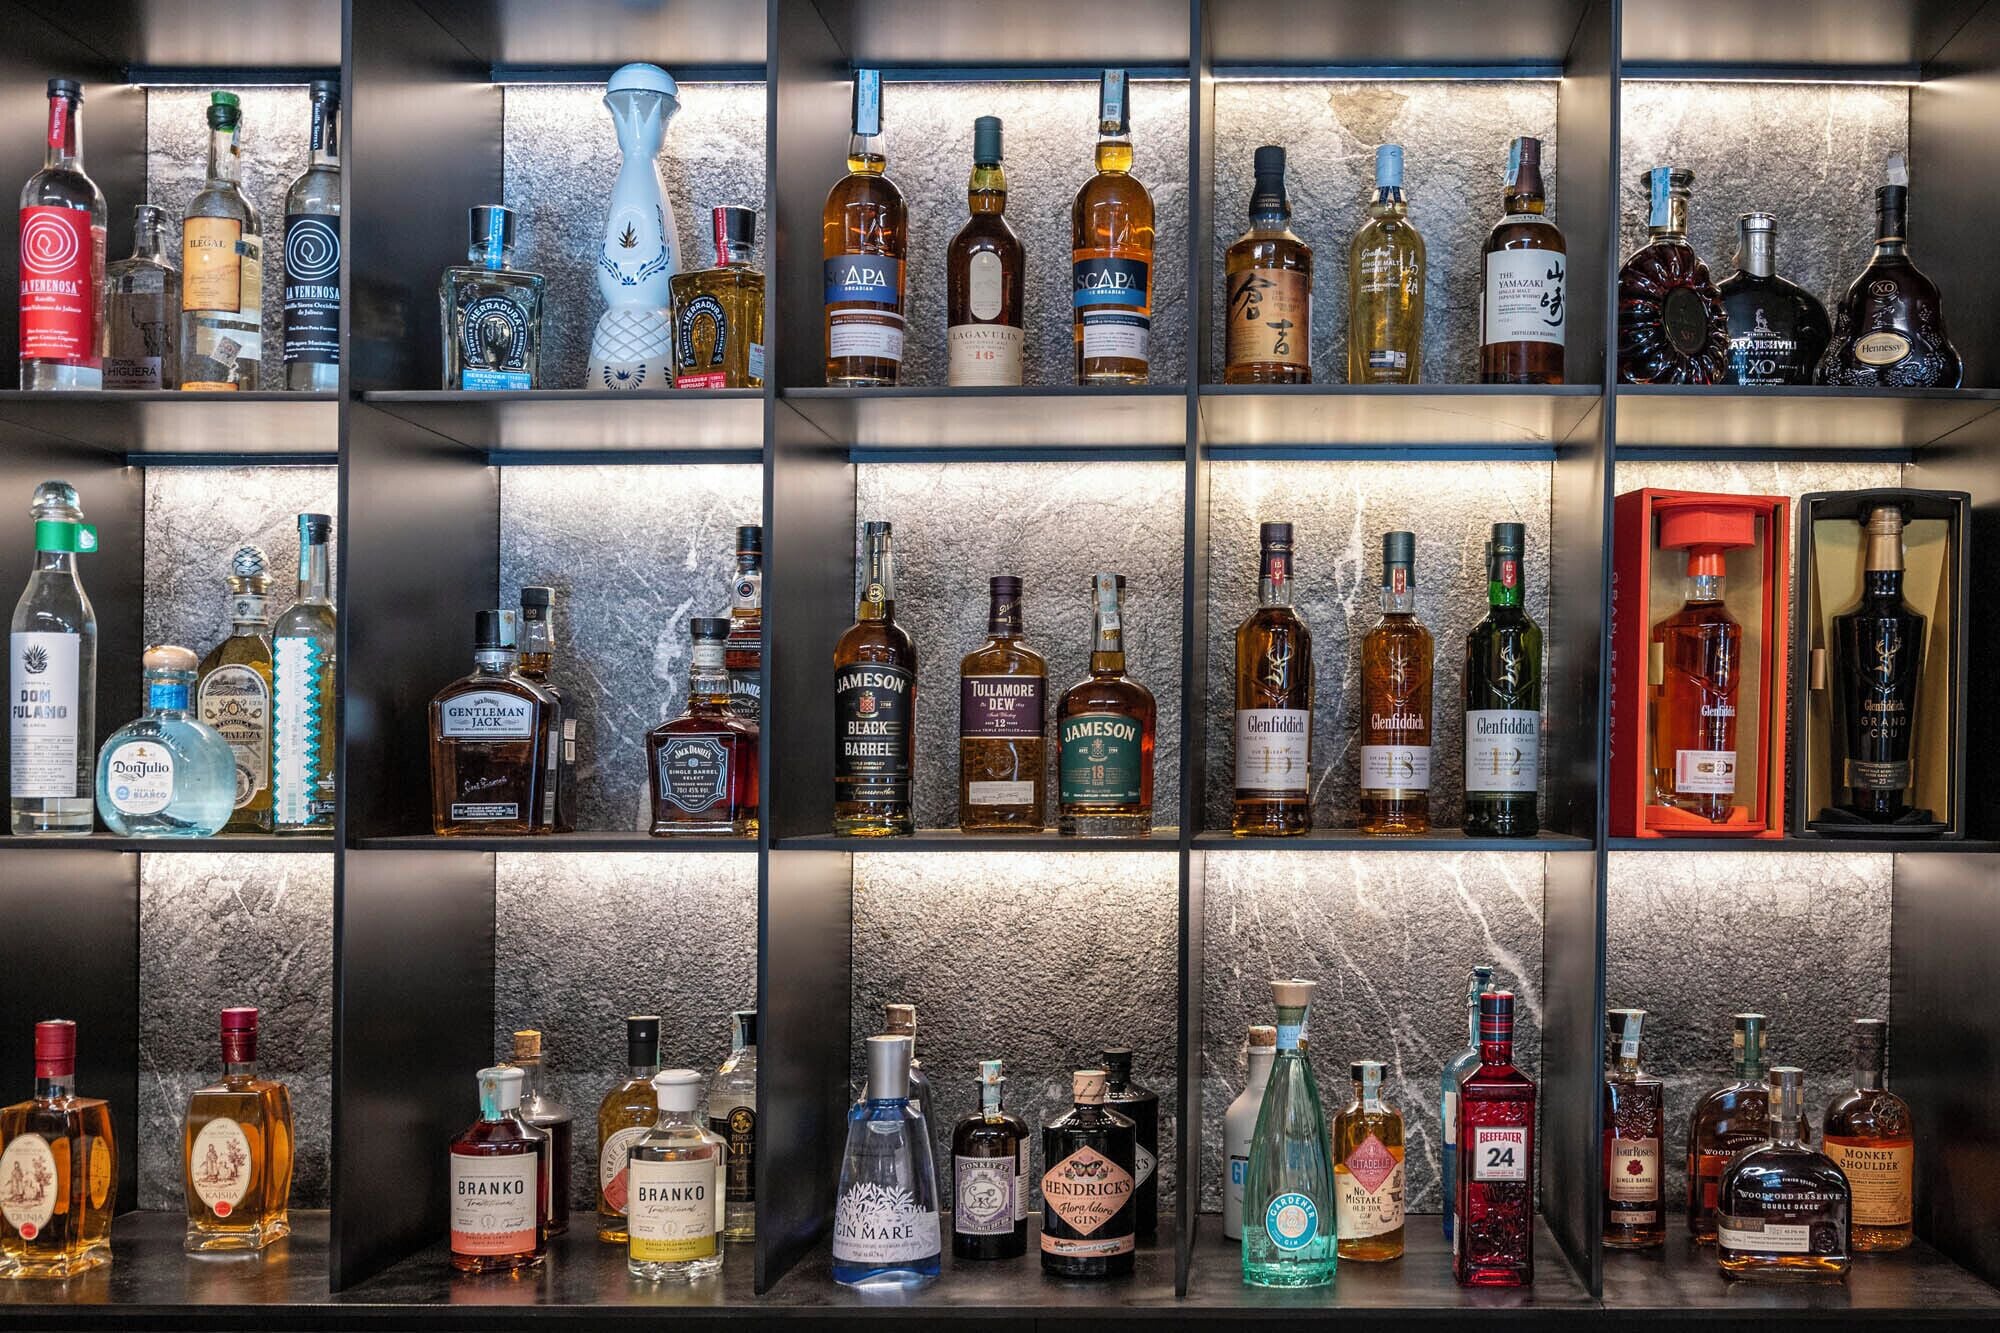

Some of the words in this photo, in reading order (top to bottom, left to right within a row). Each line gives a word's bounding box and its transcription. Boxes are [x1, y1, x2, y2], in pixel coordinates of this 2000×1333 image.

[190, 240, 226, 248] ILEGAL
[1077, 268, 1137, 289] SCAPA
[1499, 280, 1544, 288] YAMAZAKI
[30, 280, 77, 294] VENENOSA
[286, 287, 293, 299] LA
[294, 285, 340, 299] VENENOSA
[1876, 284, 1895, 293] XO
[470, 302, 522, 326] HERRADURA
[683, 301, 722, 323] HERRADURA
[953, 330, 1017, 341] LAGAVULIN
[975, 351, 995, 360] 16
[1862, 344, 1901, 353] Hennessy
[107, 367, 157, 376] HIGUERA
[1748, 359, 1776, 374] XO
[836, 673, 905, 694] JAMESON
[971, 681, 1035, 697] TULLAMORE
[13, 705, 67, 719] FULANO
[449, 707, 524, 717] GENTLEMAN
[472, 717, 502, 728] JACK
[848, 721, 888, 735] BLACK
[995, 719, 1006, 728] 12
[1248, 715, 1304, 733] Glenfiddich
[1861, 716, 1906, 726] GRAND
[1065, 721, 1136, 743] JAMESON
[1870, 728, 1898, 738] CRU
[675, 745, 688, 759] Jack
[689, 745, 712, 759] Daniel's
[845, 743, 893, 756] BARREL
[1264, 746, 1292, 774] 15
[1385, 751, 1413, 779] 18
[1490, 747, 1521, 776] 12
[113, 761, 140, 774] Don
[136, 761, 169, 778] Julio
[1092, 765, 1104, 779] 18
[1480, 1132, 1522, 1144] BEEFEATER
[1487, 1147, 1515, 1167] 24
[1845, 1149, 1893, 1159] MONKEY
[960, 1161, 998, 1172] MONKEY
[999, 1163, 1009, 1172] 47
[1351, 1159, 1390, 1169] CITADELLE
[1840, 1160, 1898, 1170] SHOULDER
[458, 1180, 524, 1195] BRANKO
[1045, 1180, 1132, 1197] HENDRICK'S
[1800, 1178, 1818, 1187] SELECT
[639, 1185, 704, 1201] BRANKO
[1354, 1187, 1365, 1195] No
[1740, 1191, 1794, 1200] WOODFORD
[1797, 1192, 1842, 1200] RESERVE
[1270, 1196, 1316, 1219] GARDENER
[11, 1213, 44, 1221] DUNJA
[1073, 1216, 1099, 1225] GIN
[835, 1222, 857, 1238] GIN
[861, 1225, 914, 1240] MARE
